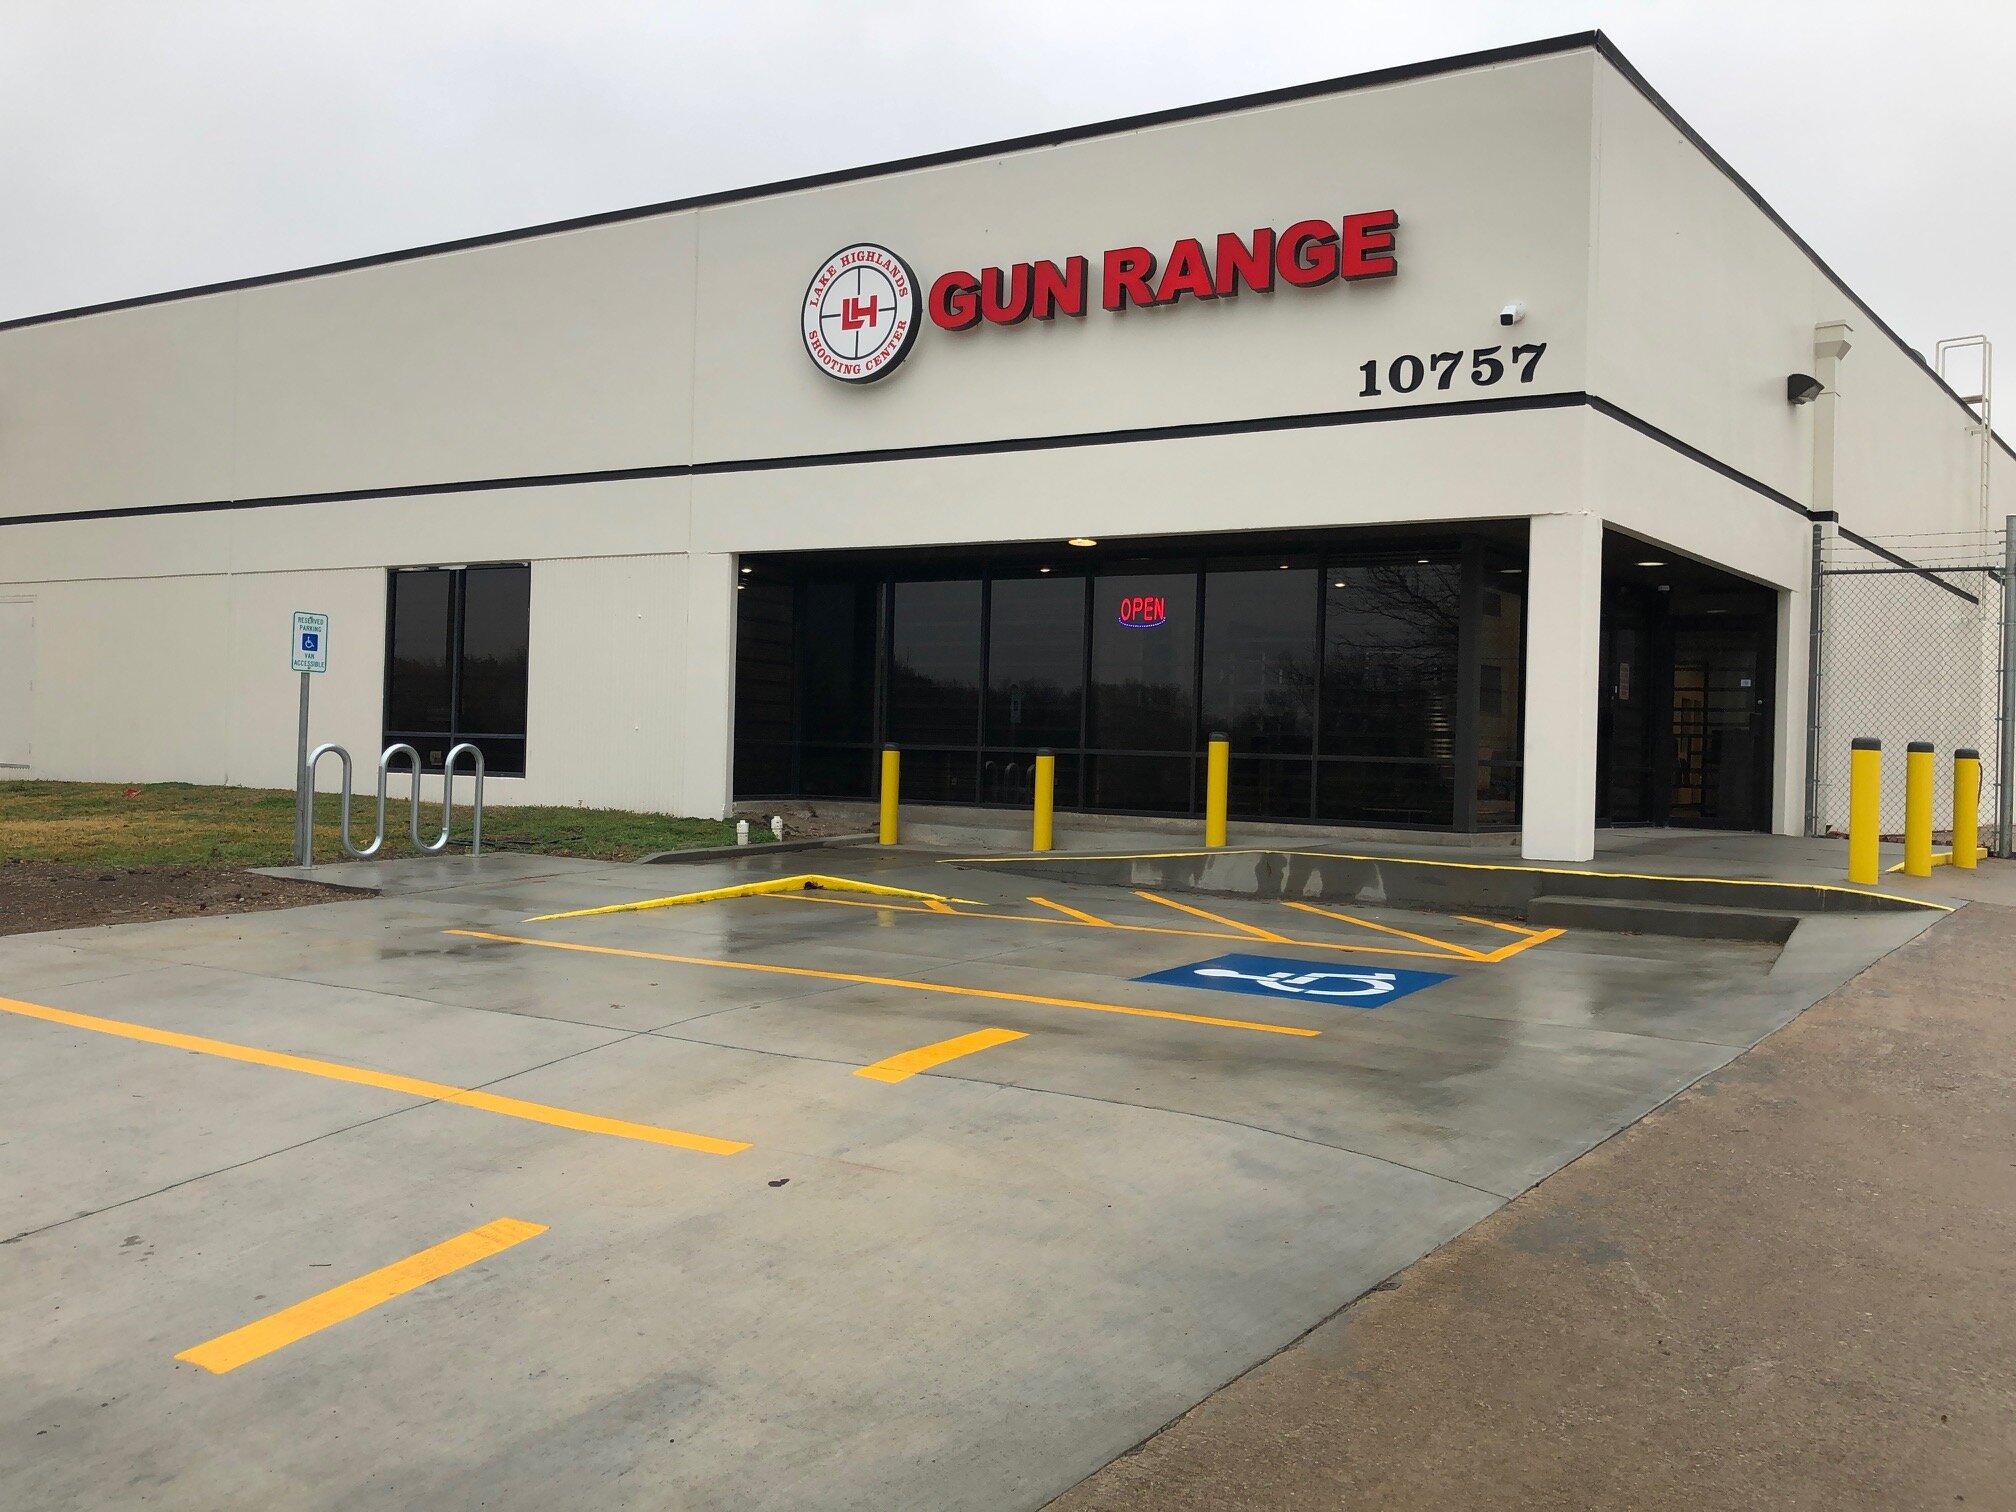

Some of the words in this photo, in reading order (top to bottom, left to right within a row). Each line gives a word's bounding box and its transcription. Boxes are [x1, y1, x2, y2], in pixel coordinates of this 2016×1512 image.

[810, 265, 837, 307] LAKE
[840, 250, 908, 298] HIGHLANDS
[928, 255, 1087, 331] GUN
[1103, 209, 1398, 312] RANGE
[808, 330, 861, 375] SHOOTING
[865, 320, 907, 371] CENTER
[1359, 342, 1547, 397] 10757
[297, 616, 324, 625] RESERVED
[1120, 596, 1165, 622] OPEN
[293, 660, 325, 668] ACCESSIBLE
